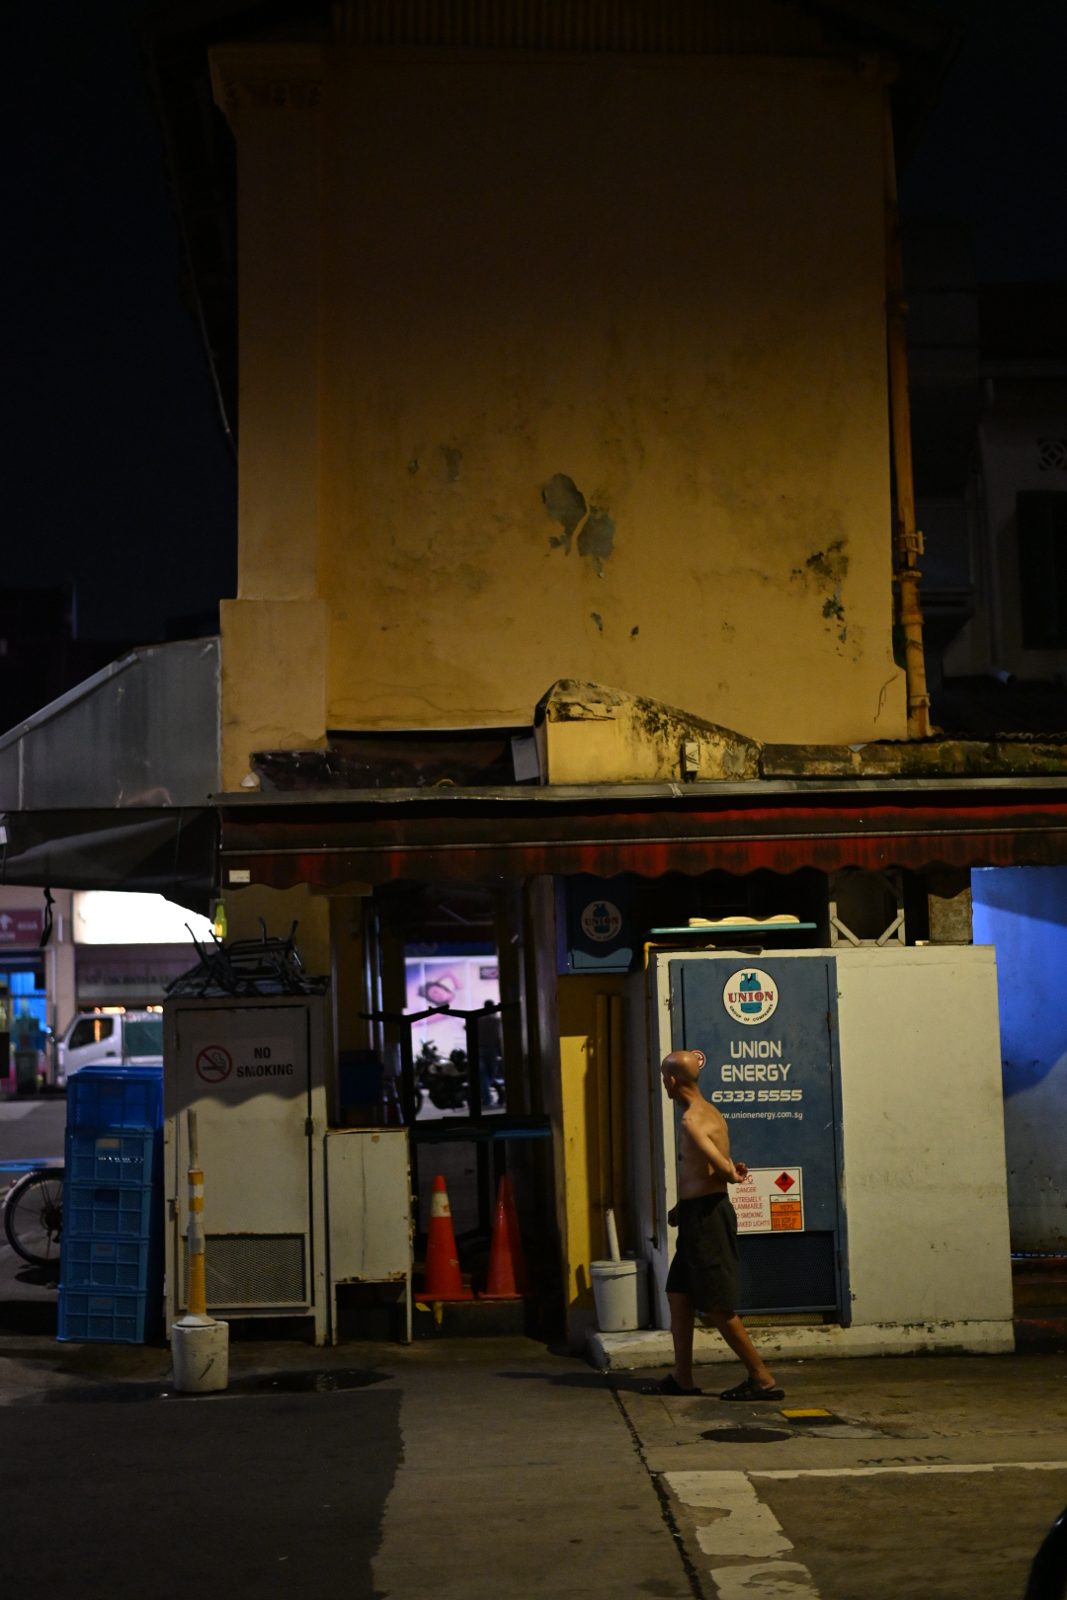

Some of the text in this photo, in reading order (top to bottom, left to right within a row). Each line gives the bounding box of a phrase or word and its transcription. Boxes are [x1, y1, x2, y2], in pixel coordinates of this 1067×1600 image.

[585, 917, 618, 926] UNION
[728, 991, 774, 1003] UNION
[254, 1047, 271, 1059] NO
[730, 1040, 782, 1059] UNION
[236, 1064, 294, 1078] SMOKING
[721, 1063, 791, 1083] ENERGY
[711, 1089, 803, 1103] 6333 5555
[720, 1110, 803, 1120] w.unionenergy.com.sg
